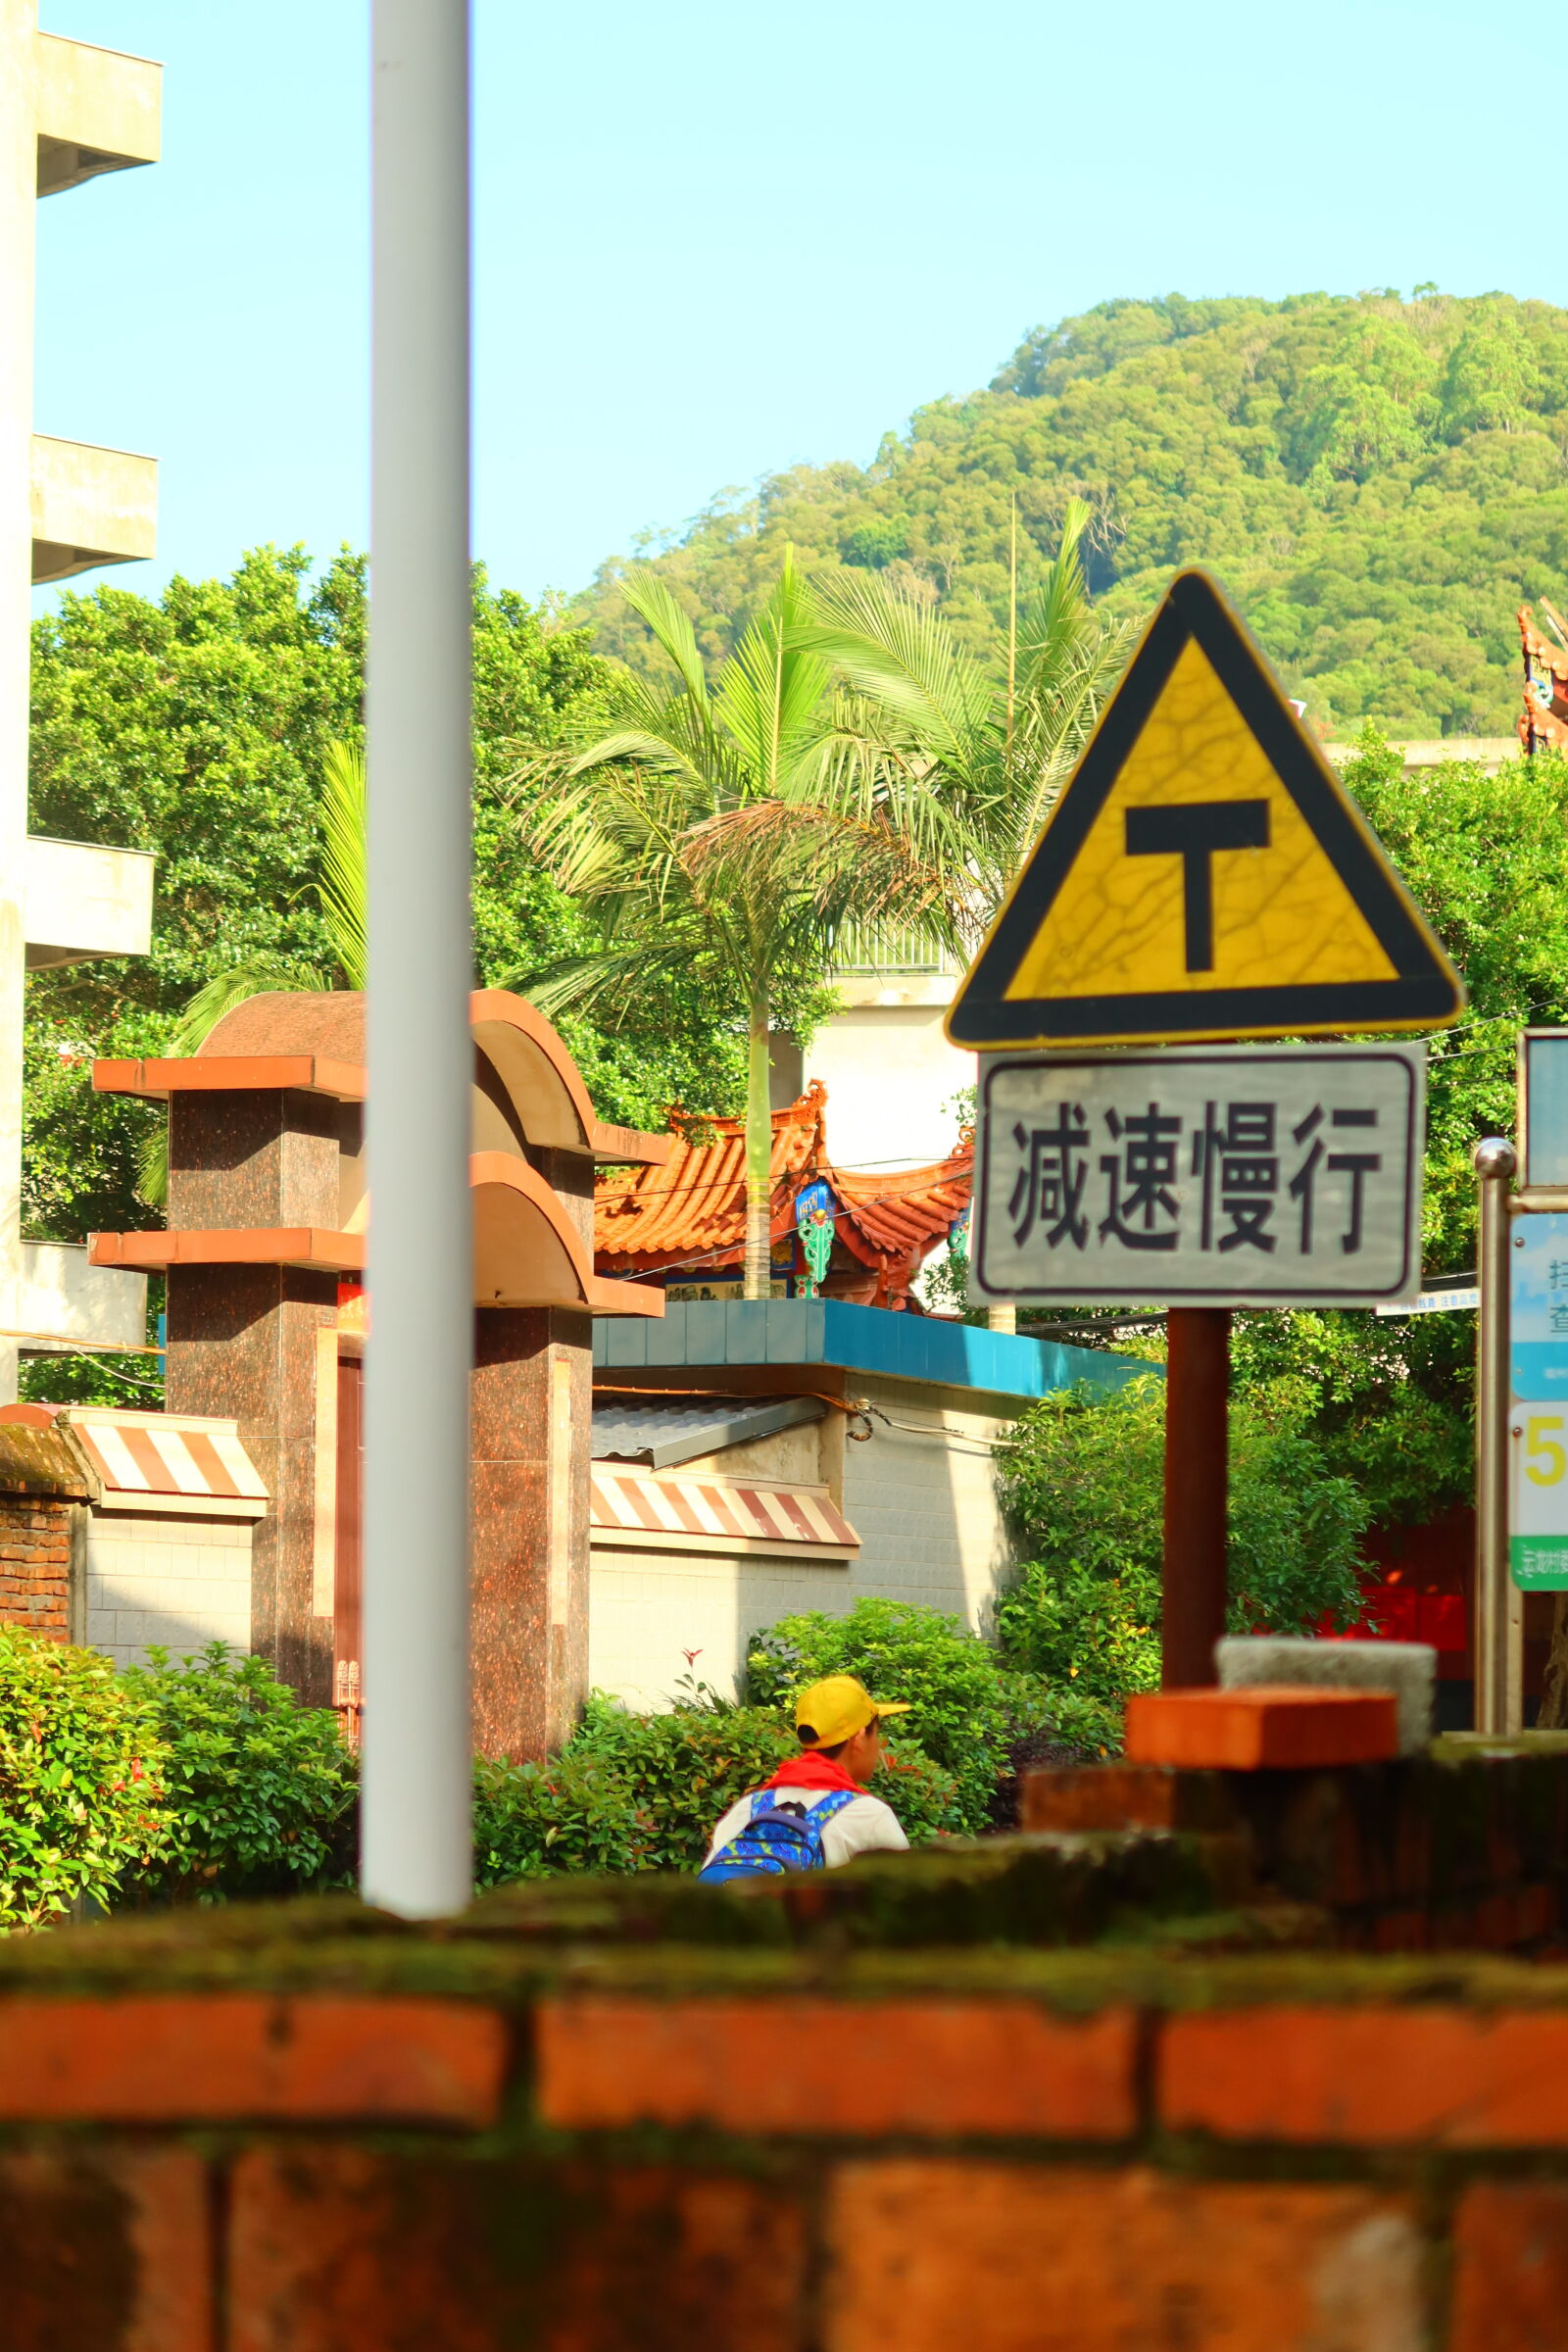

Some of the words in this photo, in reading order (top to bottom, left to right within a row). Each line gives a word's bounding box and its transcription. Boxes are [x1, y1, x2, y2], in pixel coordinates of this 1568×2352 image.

[1007, 1101, 1382, 1255] 减速慢行
[1525, 1415, 1568, 1488] 5
